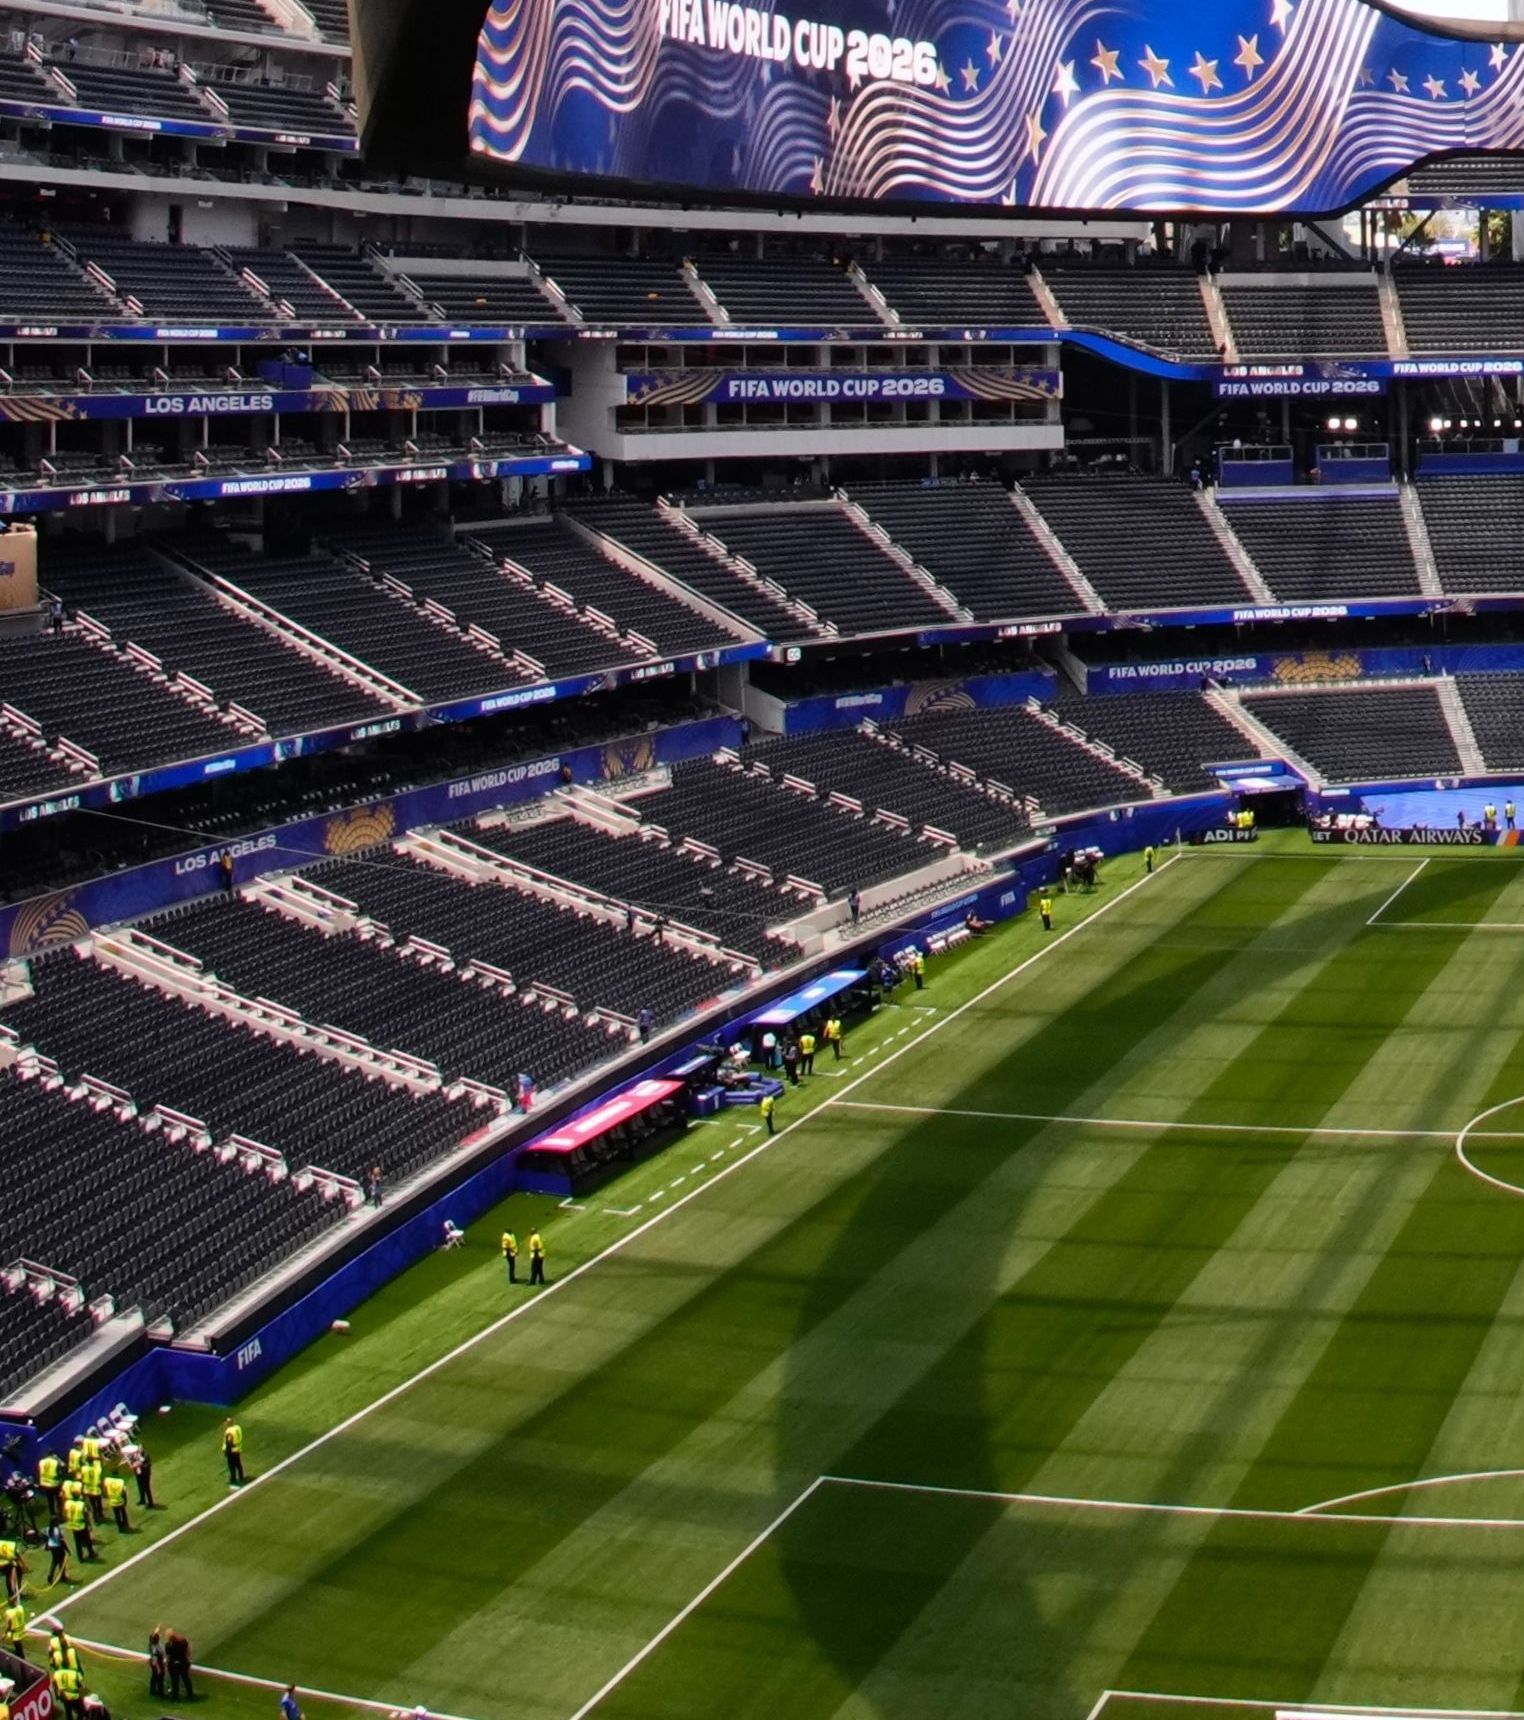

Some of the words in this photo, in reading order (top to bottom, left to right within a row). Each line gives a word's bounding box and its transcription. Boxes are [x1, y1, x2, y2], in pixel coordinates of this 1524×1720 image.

[659, 0, 705, 46] FIFA
[706, 0, 791, 62] WORLD
[794, 19, 843, 71] CUP
[847, 29, 937, 85] 2026
[1223, 366, 1248, 377] LOS
[1249, 365, 1304, 376] ANGELES
[1394, 363, 1418, 374] FIFA
[1418, 362, 1459, 373] WORLD
[1460, 362, 1483, 373] CUP
[1483, 361, 1523, 372] 2026
[729, 380, 770, 397] FIFA
[772, 379, 839, 397] WORLD
[842, 379, 879, 396] CUP
[882, 378, 945, 396] 2026
[1219, 383, 1249, 395] FIFA
[1250, 382, 1301, 394] WORLD
[1302, 382, 1330, 393] CUP
[1332, 381, 1380, 392] 2026
[145, 398, 184, 413] LOS
[187, 395, 273, 412] ANGELES
[222, 482, 240, 494] FIFA
[241, 480, 267, 492] WORLD
[269, 479, 284, 491] CUP
[284, 477, 311, 490] 2026
[1233, 610, 1254, 621] FIFA
[1255, 608, 1290, 619] WORLD
[1291, 607, 1312, 617] CUP
[1313, 605, 1347, 617] 2026
[1109, 667, 1137, 679] FIFA
[1138, 664, 1184, 677] WORLD
[1185, 661, 1211, 674] CUP
[1213, 658, 1256, 673] 2026
[449, 780, 471, 799] FIFA
[471, 771, 507, 792] WORLD
[507, 766, 527, 783] CUP
[527, 757, 560, 778] 2026
[1344, 830, 1402, 844] QATAR
[1409, 829, 1482, 843] AIRWAYS
[175, 854, 206, 875] LOS
[209, 834, 276, 866] ANGELES
[237, 1338, 262, 1370] FIFA
